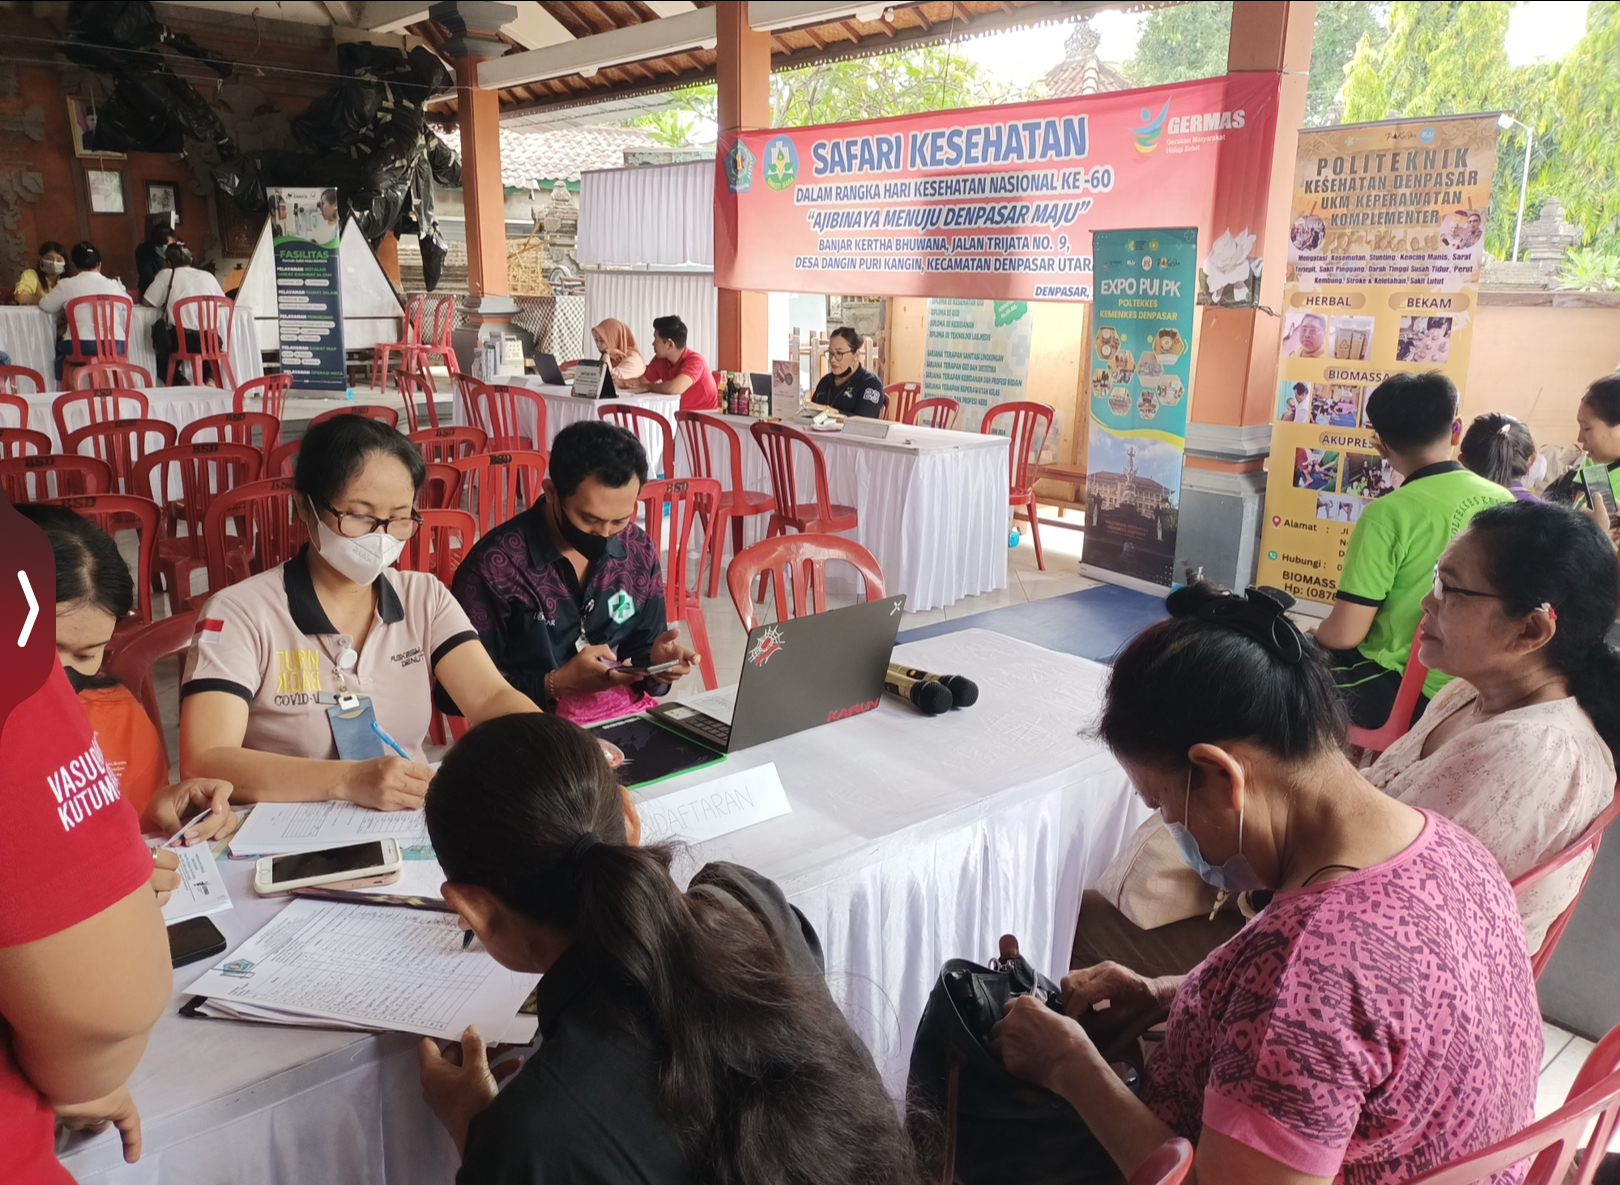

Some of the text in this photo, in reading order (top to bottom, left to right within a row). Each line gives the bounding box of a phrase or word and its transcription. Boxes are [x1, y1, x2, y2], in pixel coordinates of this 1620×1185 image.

[1167, 109, 1246, 135] GERMAS
[811, 116, 1087, 175] SAFARI KESEHATAN
[1166, 134, 1226, 146] Gerakan Masyarakat
[1166, 146, 1184, 154] Hidup
[1316, 148, 1469, 176] POLITEKNIK
[796, 186, 833, 203] DALAM
[835, 184, 881, 201] RANGKA
[884, 182, 911, 199] HARI
[914, 177, 986, 198] KESEHATAN
[989, 173, 1057, 194] NASIONAL
[1061, 171, 1081, 190] KE
[1304, 170, 1478, 194] KESEHATAN DENPASAR
[1321, 191, 1462, 210] UKM KEPERAWATAN
[883, 208, 942, 231] MENUJU
[943, 204, 1030, 227] DENPASAR
[1330, 210, 1439, 227] KOMPLEMENTER
[819, 235, 1070, 253] BANJAR KERTHA BHUWANA, JALAN TRIJATA NO. 9,
[280, 250, 329, 259] FASILITAS
[1400, 253, 1426, 261] Kencing
[795, 257, 819, 269] DESA
[821, 257, 856, 270] DANGIN
[859, 257, 881, 270] PURI
[884, 258, 924, 273] KANGIN,
[927, 257, 991, 271] KECAMATAN
[994, 257, 1054, 271] DENPASAR
[1035, 286, 1089, 298] DENPASAR,
[1101, 278, 1181, 297] EXPO PUI PK
[1118, 299, 1158, 308] POLTEKKES
[1306, 296, 1452, 308] HERBAL BEKAM
[1100, 310, 1178, 320] KEMENKES DENPASAR
[944, 351, 962, 359] TERAPAN
[943, 361, 961, 370] TERAPAN
[942, 372, 960, 381] TERAPAN
[1007, 378, 1022, 387] BIDAN
[1328, 370, 1391, 382] BIOMASSA
[941, 383, 960, 392] TERAPAN
[489, 453, 513, 465] BSD
[666, 481, 689, 493] BSD
[1284, 519, 1317, 532] Alamat
[1282, 553, 1321, 569] Hubungi
[1282, 570, 1338, 589] BIOMASS
[1284, 583, 1303, 595] Hp:
[276, 649, 319, 671] TURN
